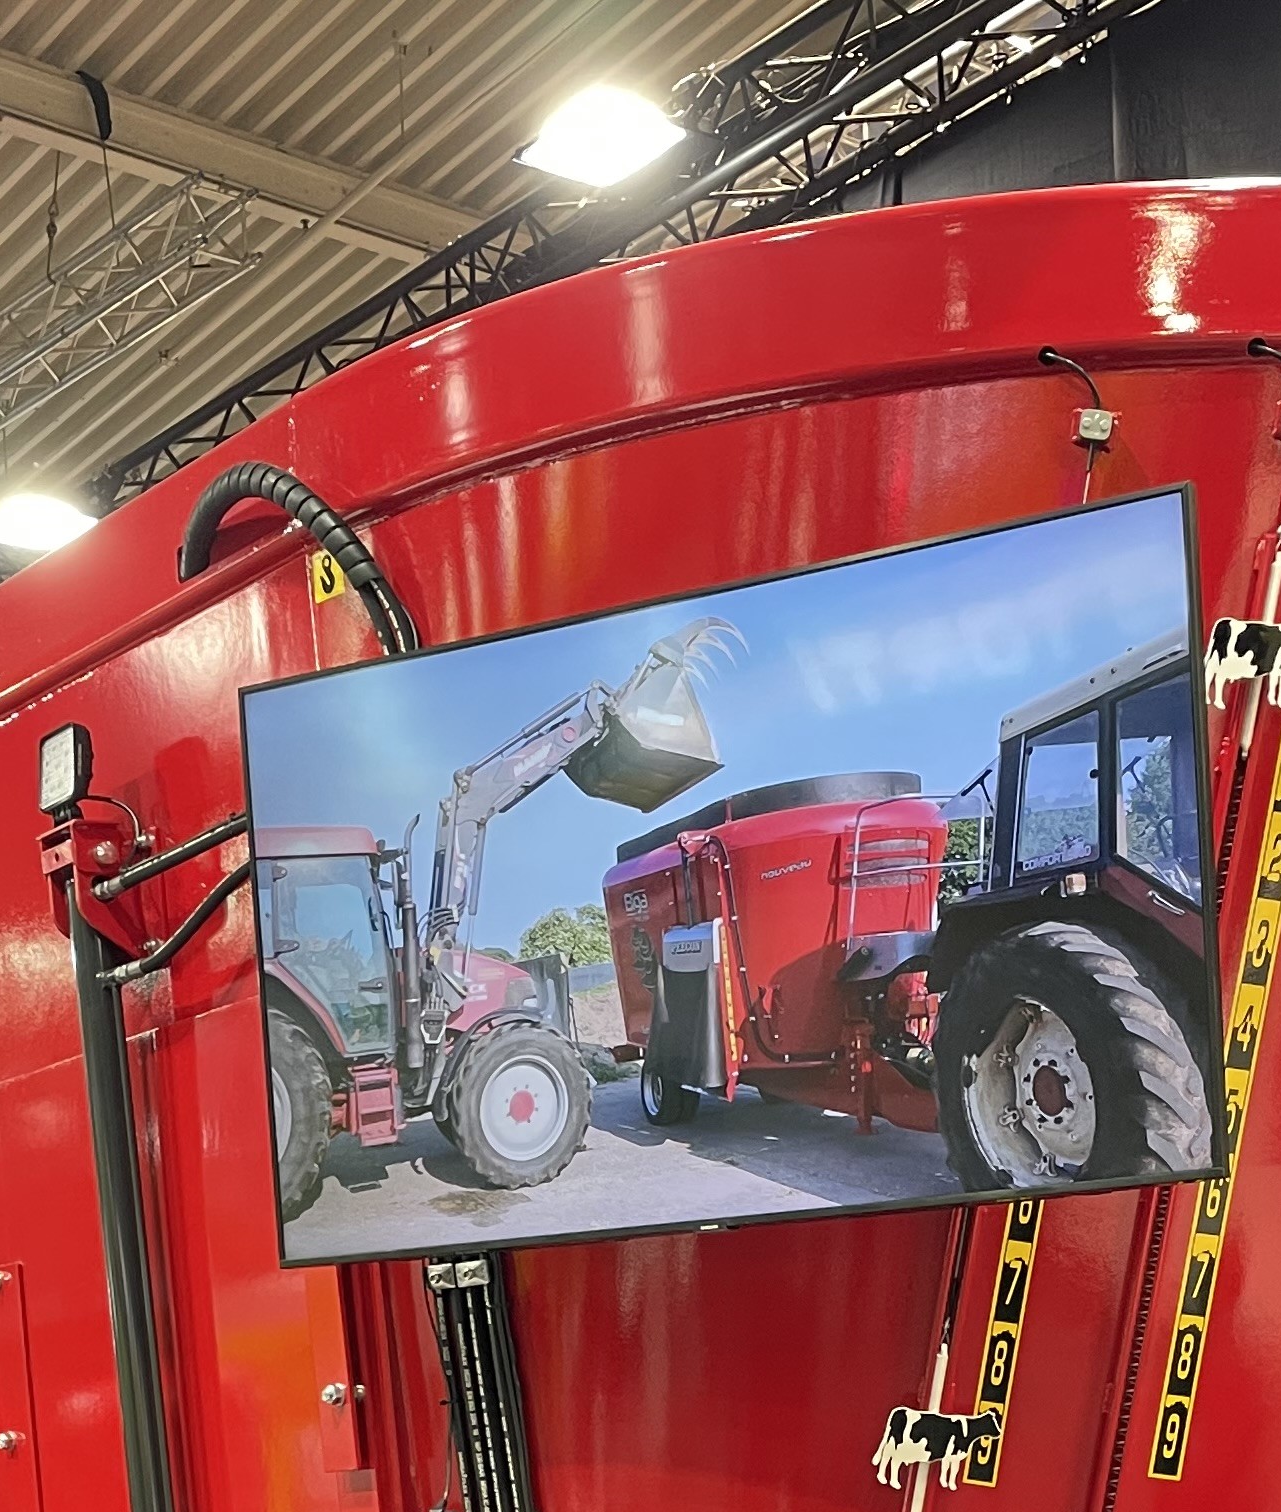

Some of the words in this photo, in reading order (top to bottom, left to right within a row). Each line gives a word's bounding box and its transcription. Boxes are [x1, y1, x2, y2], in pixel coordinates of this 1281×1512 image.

[1251, 919, 1270, 969] 3
[1236, 1004, 1255, 1052] 4
[1225, 1088, 1241, 1135] 5
[1205, 1178, 1221, 1218] 6
[1006, 1260, 1023, 1305] 7
[1196, 1251, 1211, 1299] 7
[990, 1340, 1008, 1386] 8
[1175, 1333, 1196, 1380] 8
[1162, 1412, 1182, 1460] 9
